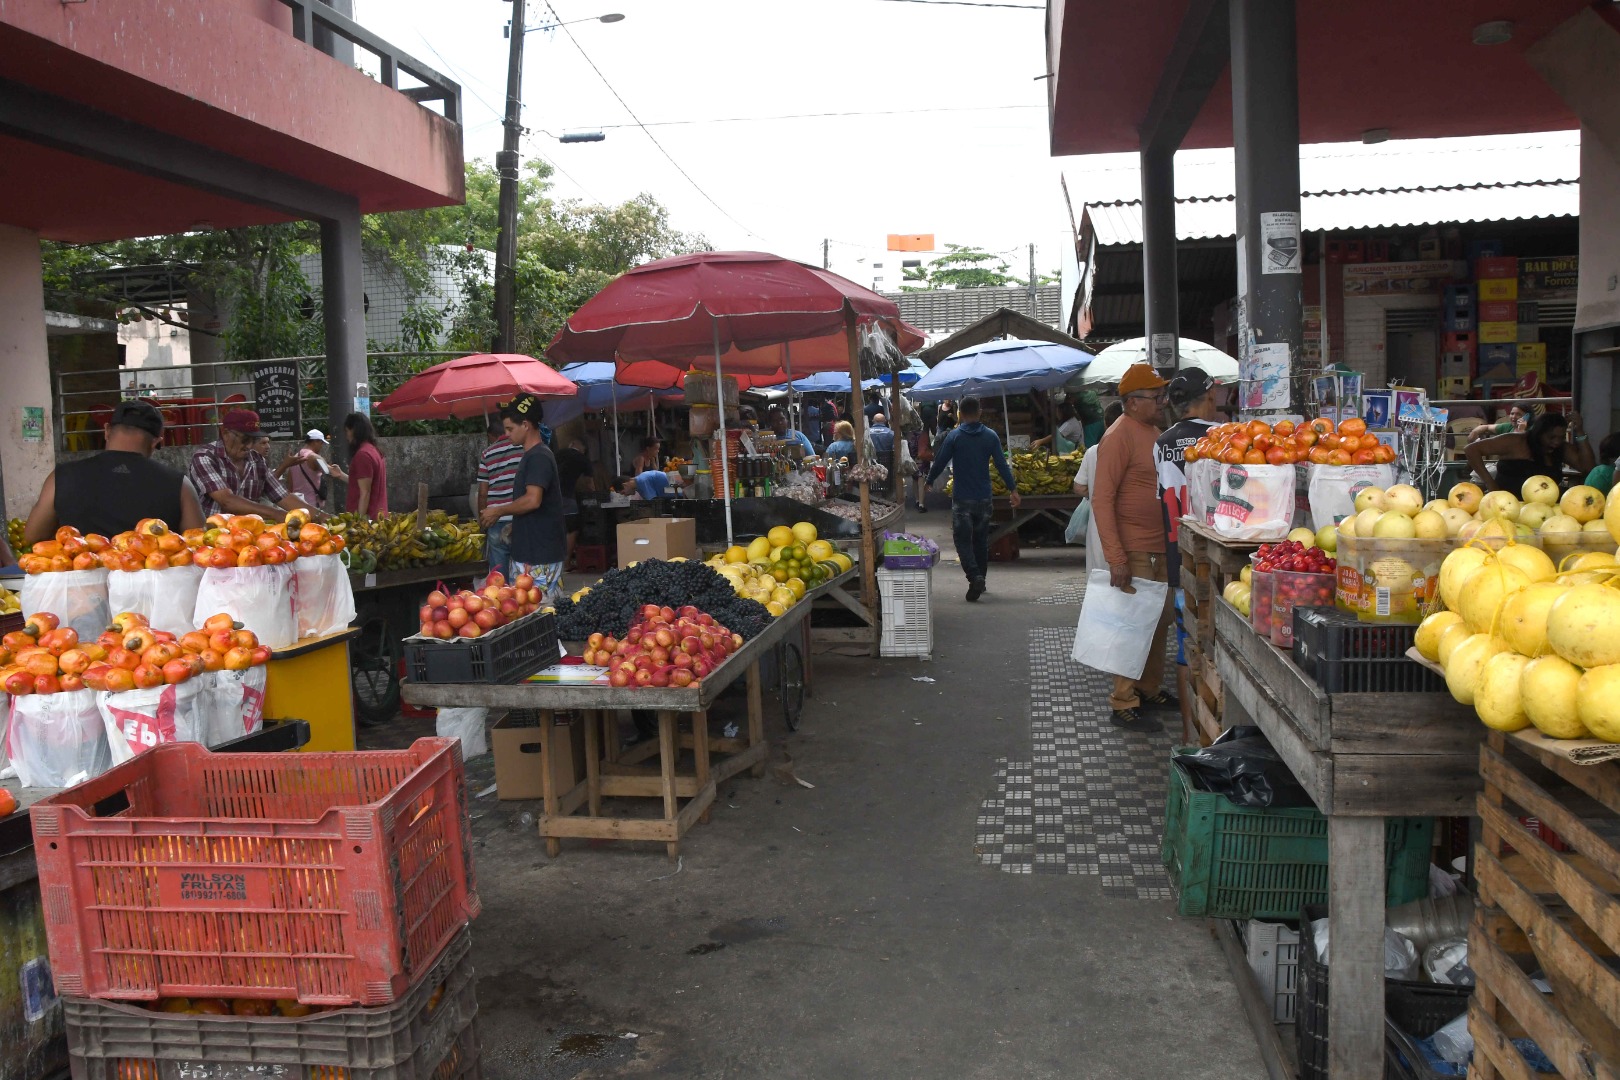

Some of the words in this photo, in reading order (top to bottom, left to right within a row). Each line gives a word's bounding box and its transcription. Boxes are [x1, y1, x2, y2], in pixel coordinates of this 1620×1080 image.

[1525, 261, 1548, 272] BAR
[1552, 260, 1567, 271] DO
[254, 366, 295, 379] BARBEARIA
[1176, 438, 1197, 446] VASCO
[181, 873, 245, 882] WILSON
[181, 881, 246, 890] FRUTAS
